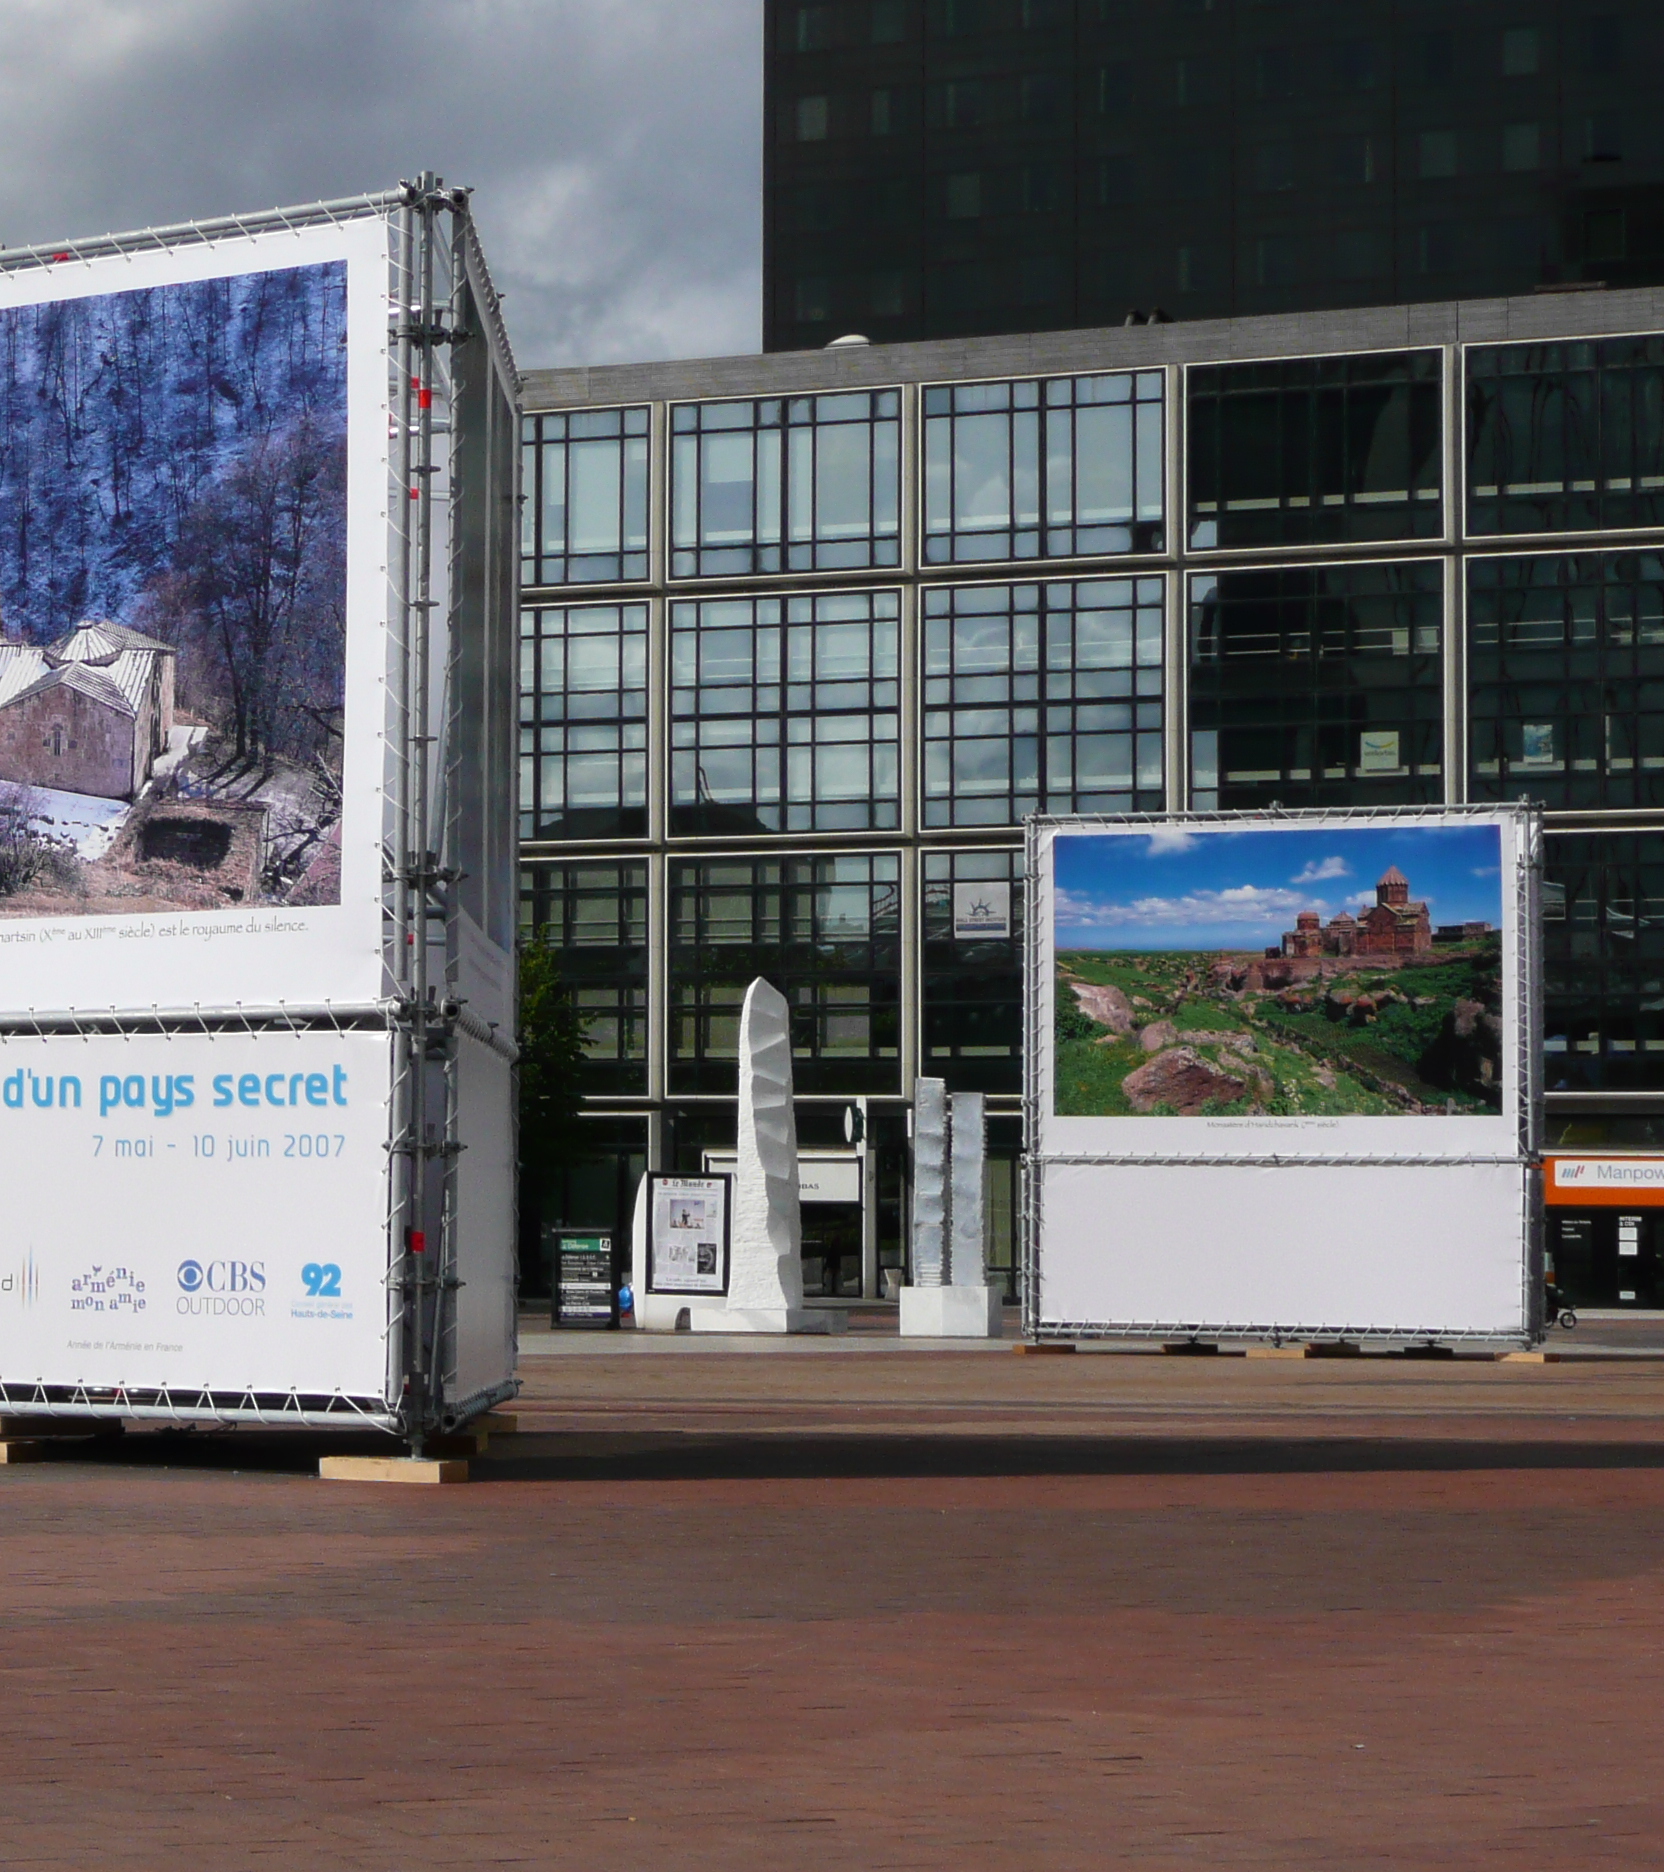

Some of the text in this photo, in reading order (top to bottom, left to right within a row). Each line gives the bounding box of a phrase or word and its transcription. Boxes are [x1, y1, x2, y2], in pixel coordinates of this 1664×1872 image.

[68, 931, 80, 940] au
[118, 921, 154, 939] siècle)
[158, 925, 175, 936] est
[178, 919, 190, 935] le
[192, 925, 242, 939] royaume
[246, 916, 262, 933] du
[264, 915, 308, 932] silence.
[4, 1069, 82, 1109] d'un
[101, 1071, 196, 1118] pays
[214, 1065, 349, 1107] secret
[92, 1134, 106, 1156] 7
[114, 1136, 154, 1156] mai
[194, 1134, 216, 1156] 10
[227, 1135, 270, 1162] juin
[284, 1134, 346, 1157] 2007
[71, 1267, 146, 1293] arménie
[206, 1260, 266, 1293] CBS
[300, 1262, 342, 1298] 92
[71, 1292, 146, 1313] mon amie
[176, 1296, 266, 1316] OUTDOOR
[290, 1308, 353, 1319] Hauts-de-Seine
[93, 1341, 104, 1350] de
[156, 1342, 184, 1352] France
